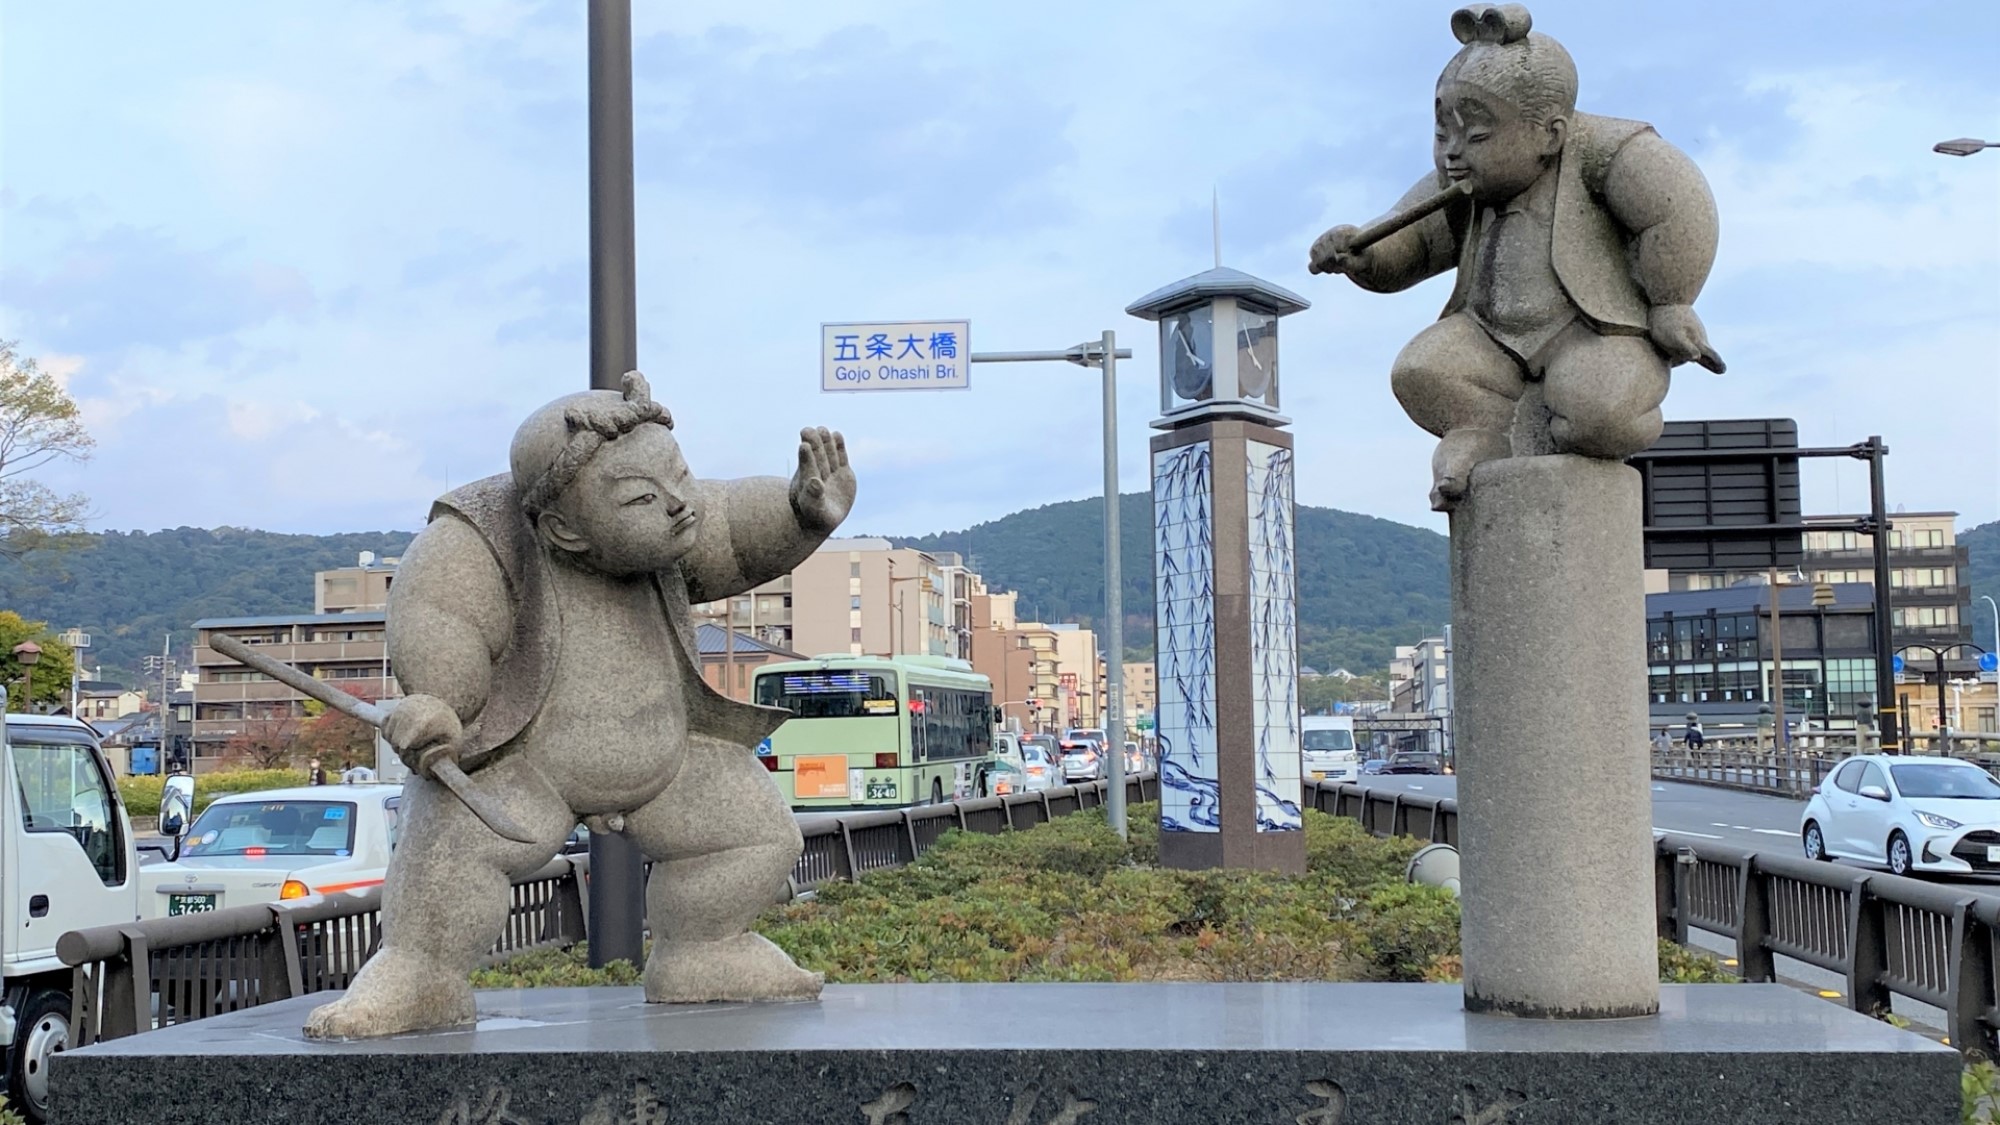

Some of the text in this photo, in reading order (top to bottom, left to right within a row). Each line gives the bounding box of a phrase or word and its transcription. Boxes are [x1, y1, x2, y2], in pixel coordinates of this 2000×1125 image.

[833, 332, 957, 361] 五条大橋
[835, 366, 871, 383] Gojo
[878, 365, 930, 380] Ohashi
